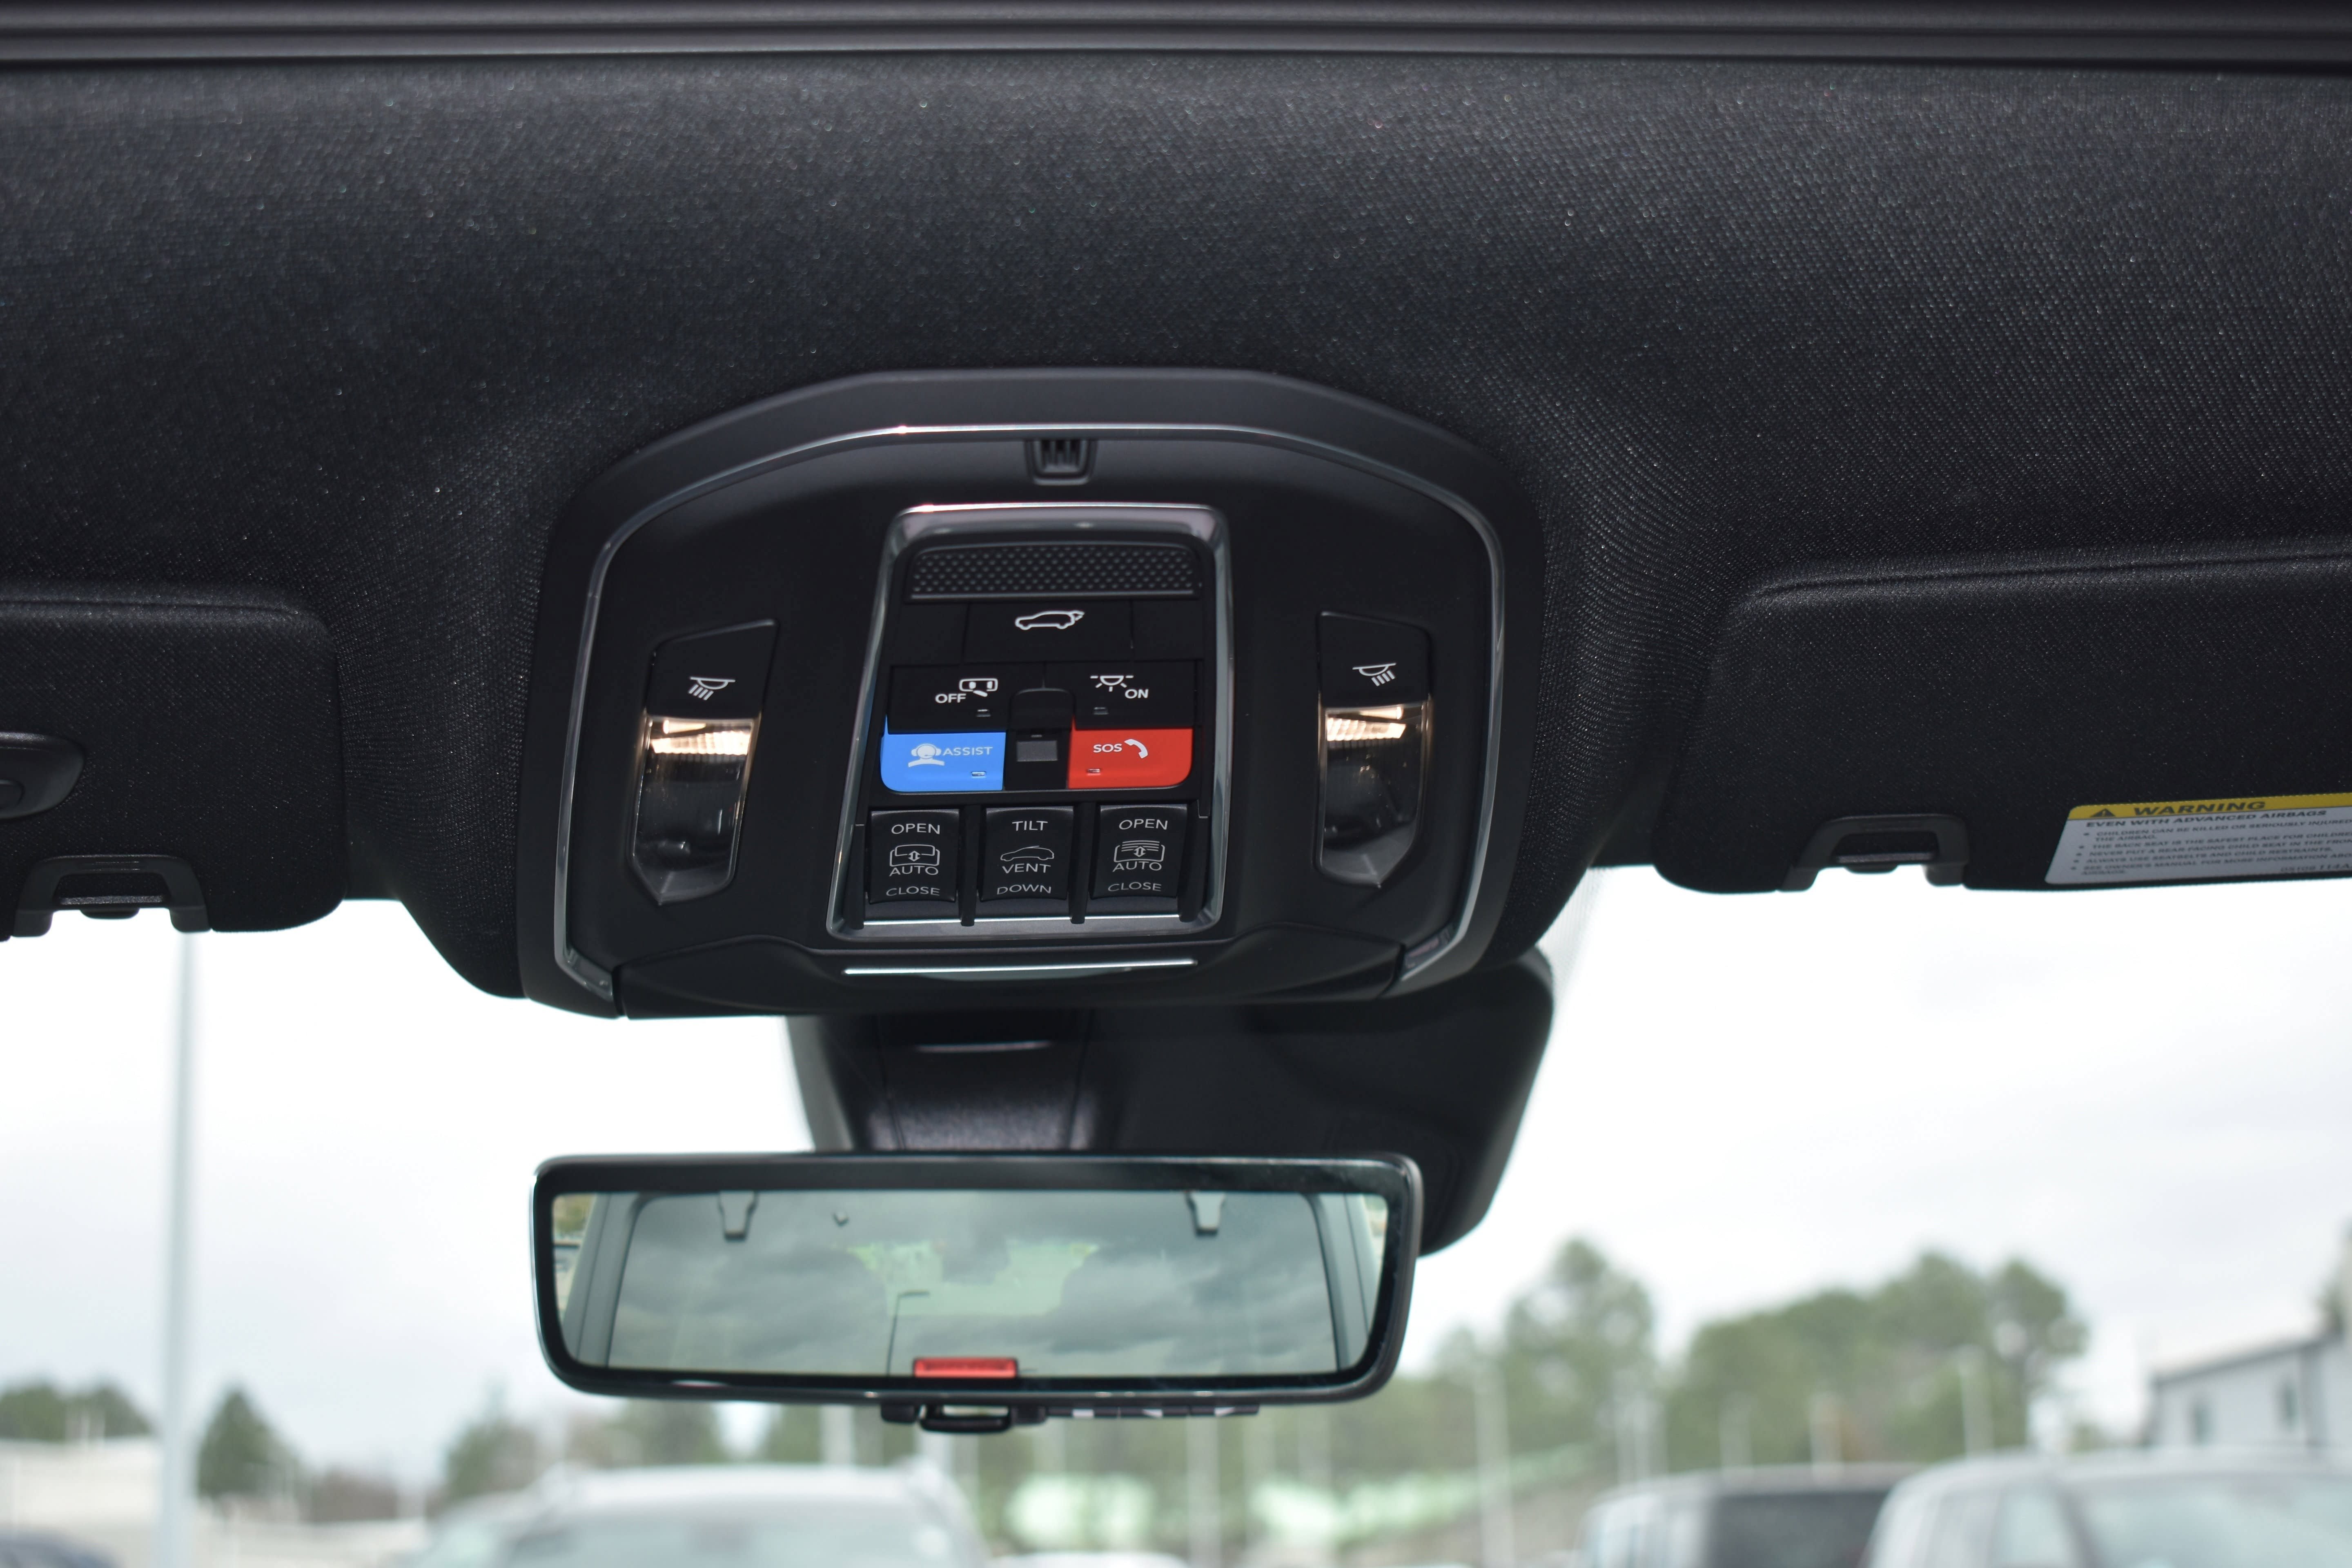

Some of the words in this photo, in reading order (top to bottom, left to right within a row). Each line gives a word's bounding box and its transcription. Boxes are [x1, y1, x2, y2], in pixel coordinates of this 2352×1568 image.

[935, 693, 966, 704] OFF
[1125, 688, 1149, 699] ON
[943, 746, 993, 756] ASSIST
[1093, 743, 1122, 753] SOS
[2134, 802, 2265, 815] WARNING
[2173, 814, 2256, 823] ADVANCED
[2261, 810, 2327, 818] AIRBAGS
[891, 823, 941, 835] OPEN
[1012, 820, 1048, 831] TILT
[1119, 819, 1168, 831] OPEN
[889, 864, 939, 876] AUTO
[1002, 864, 1051, 874] VENT
[1112, 861, 1162, 873] AUTO
[886, 885, 940, 897] CLOSE
[996, 884, 1052, 895] DOWN
[1107, 881, 1162, 893] CLOSE
